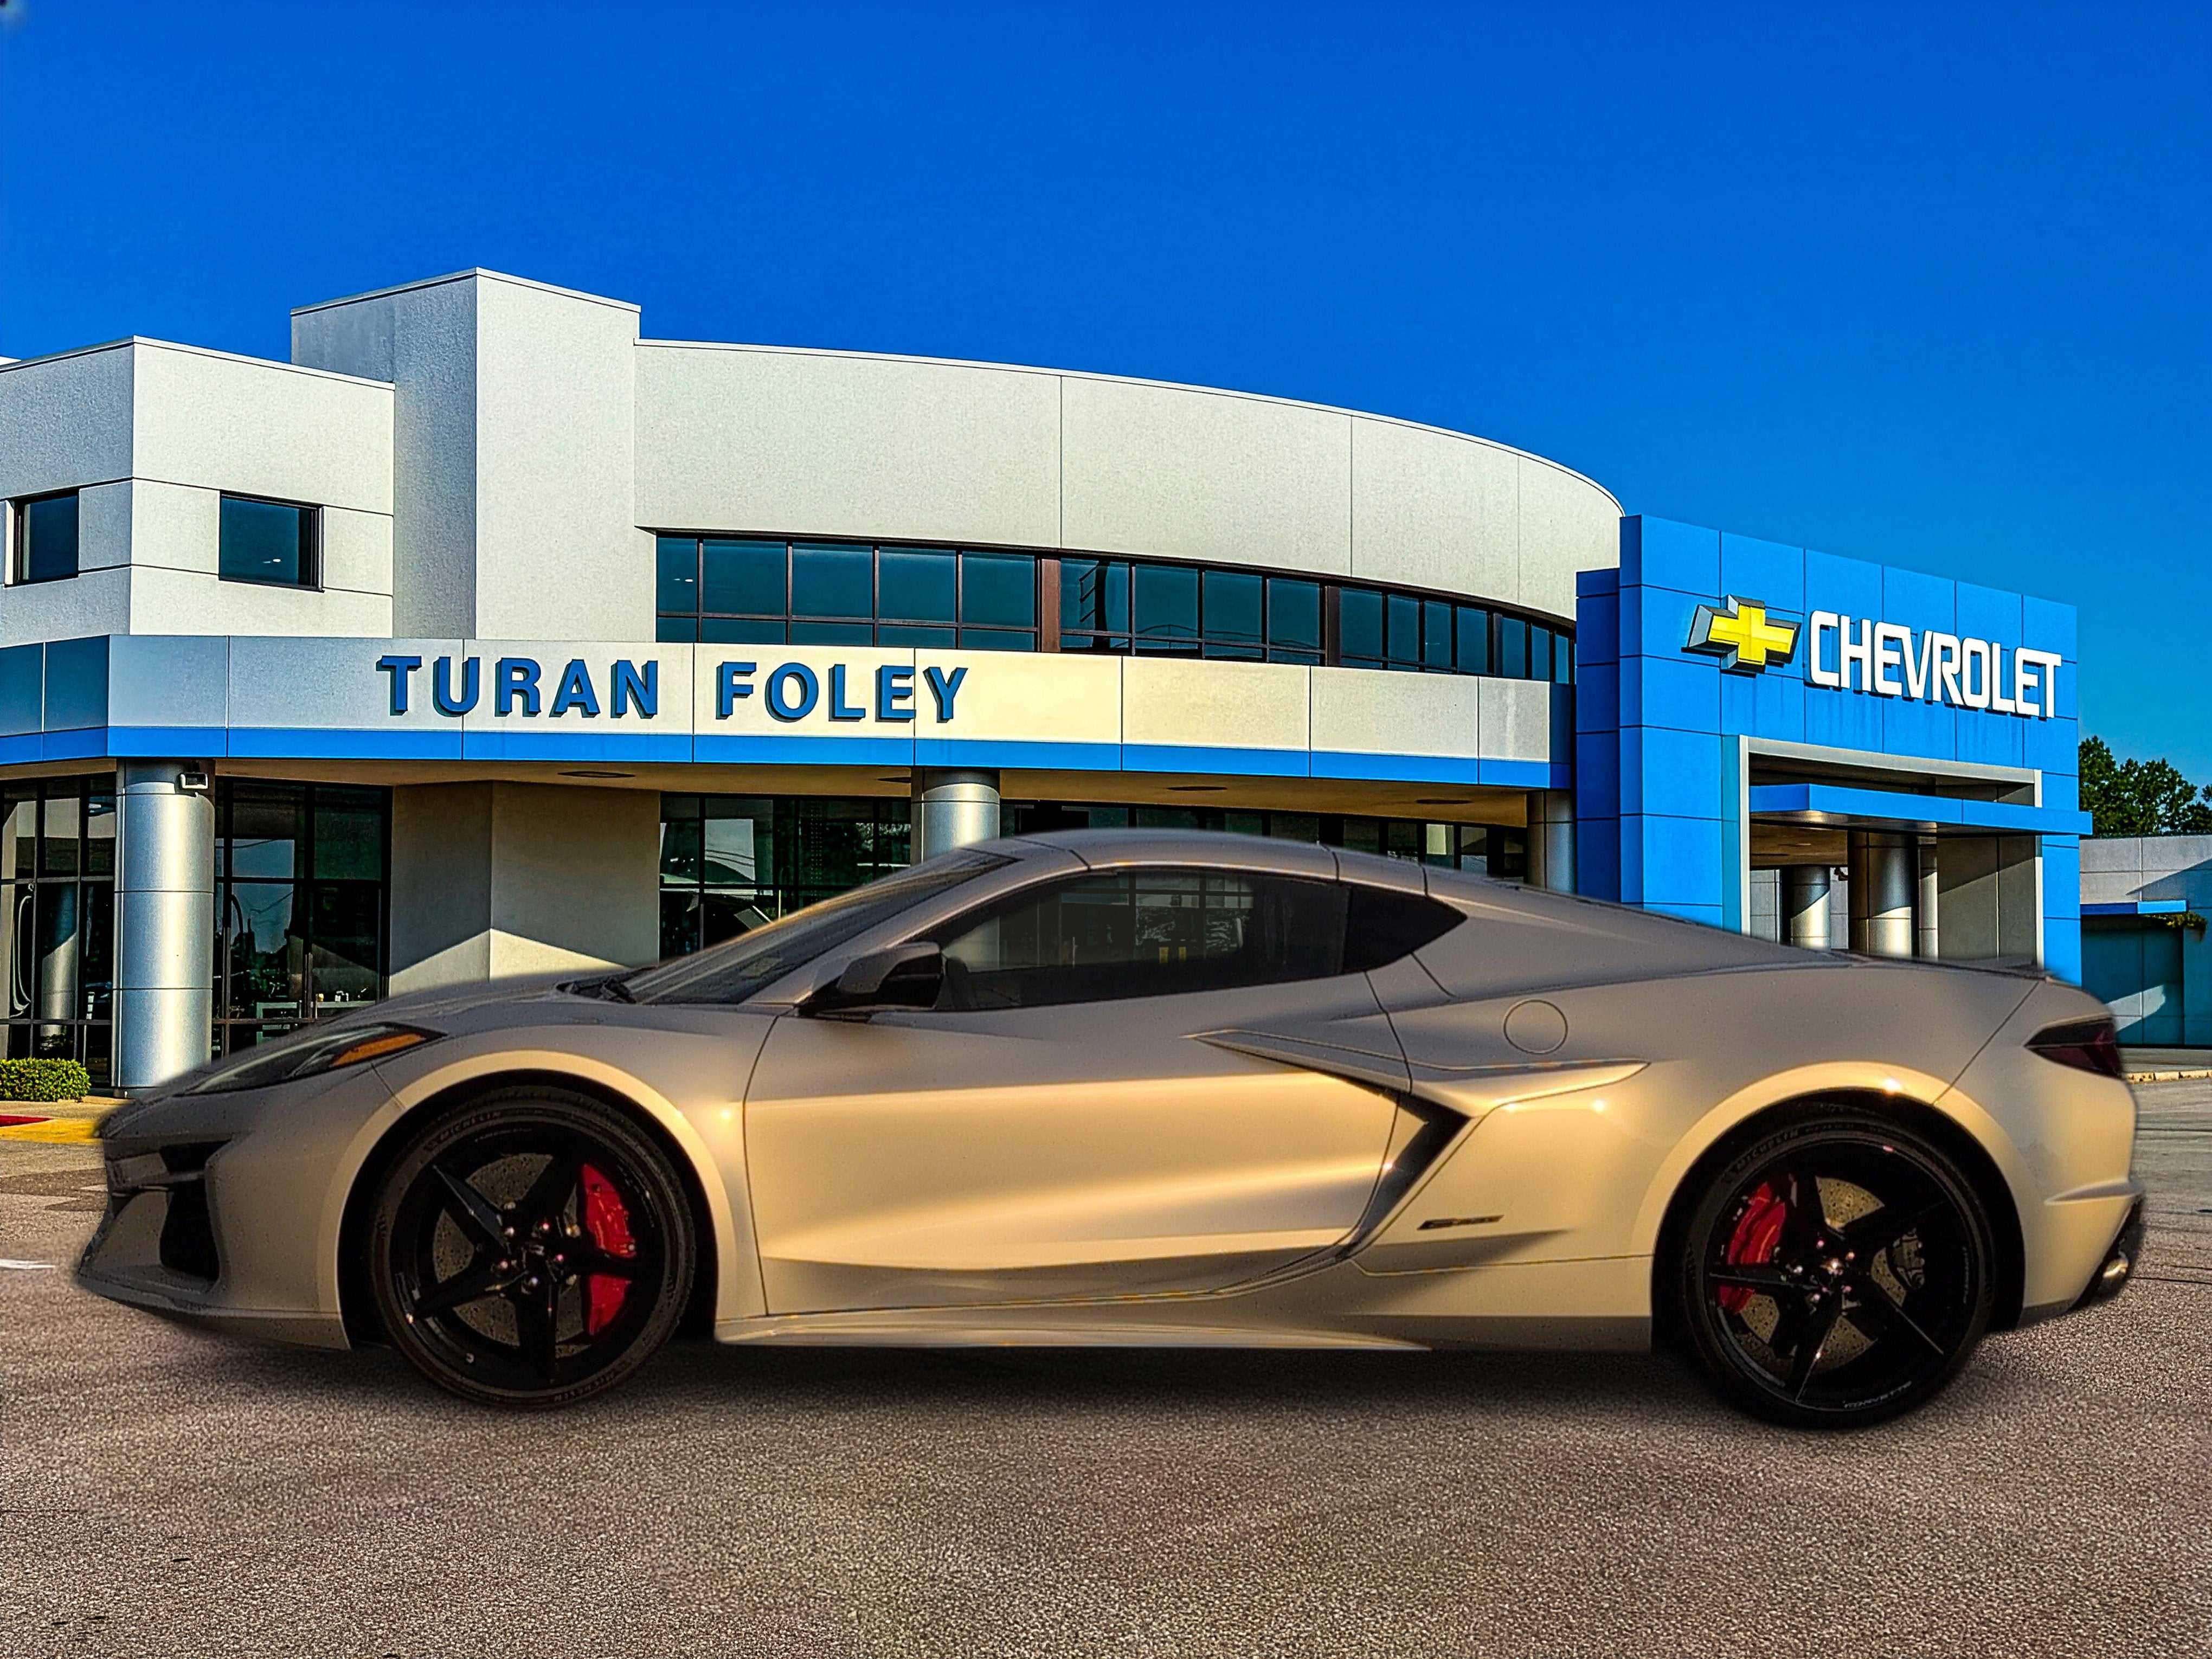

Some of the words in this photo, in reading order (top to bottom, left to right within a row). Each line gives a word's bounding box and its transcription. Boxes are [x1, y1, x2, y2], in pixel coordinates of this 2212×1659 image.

[375, 655, 658, 719] TURAN
[716, 660, 969, 723] FOLEY
[1809, 610, 2062, 719] CHEVROLET
